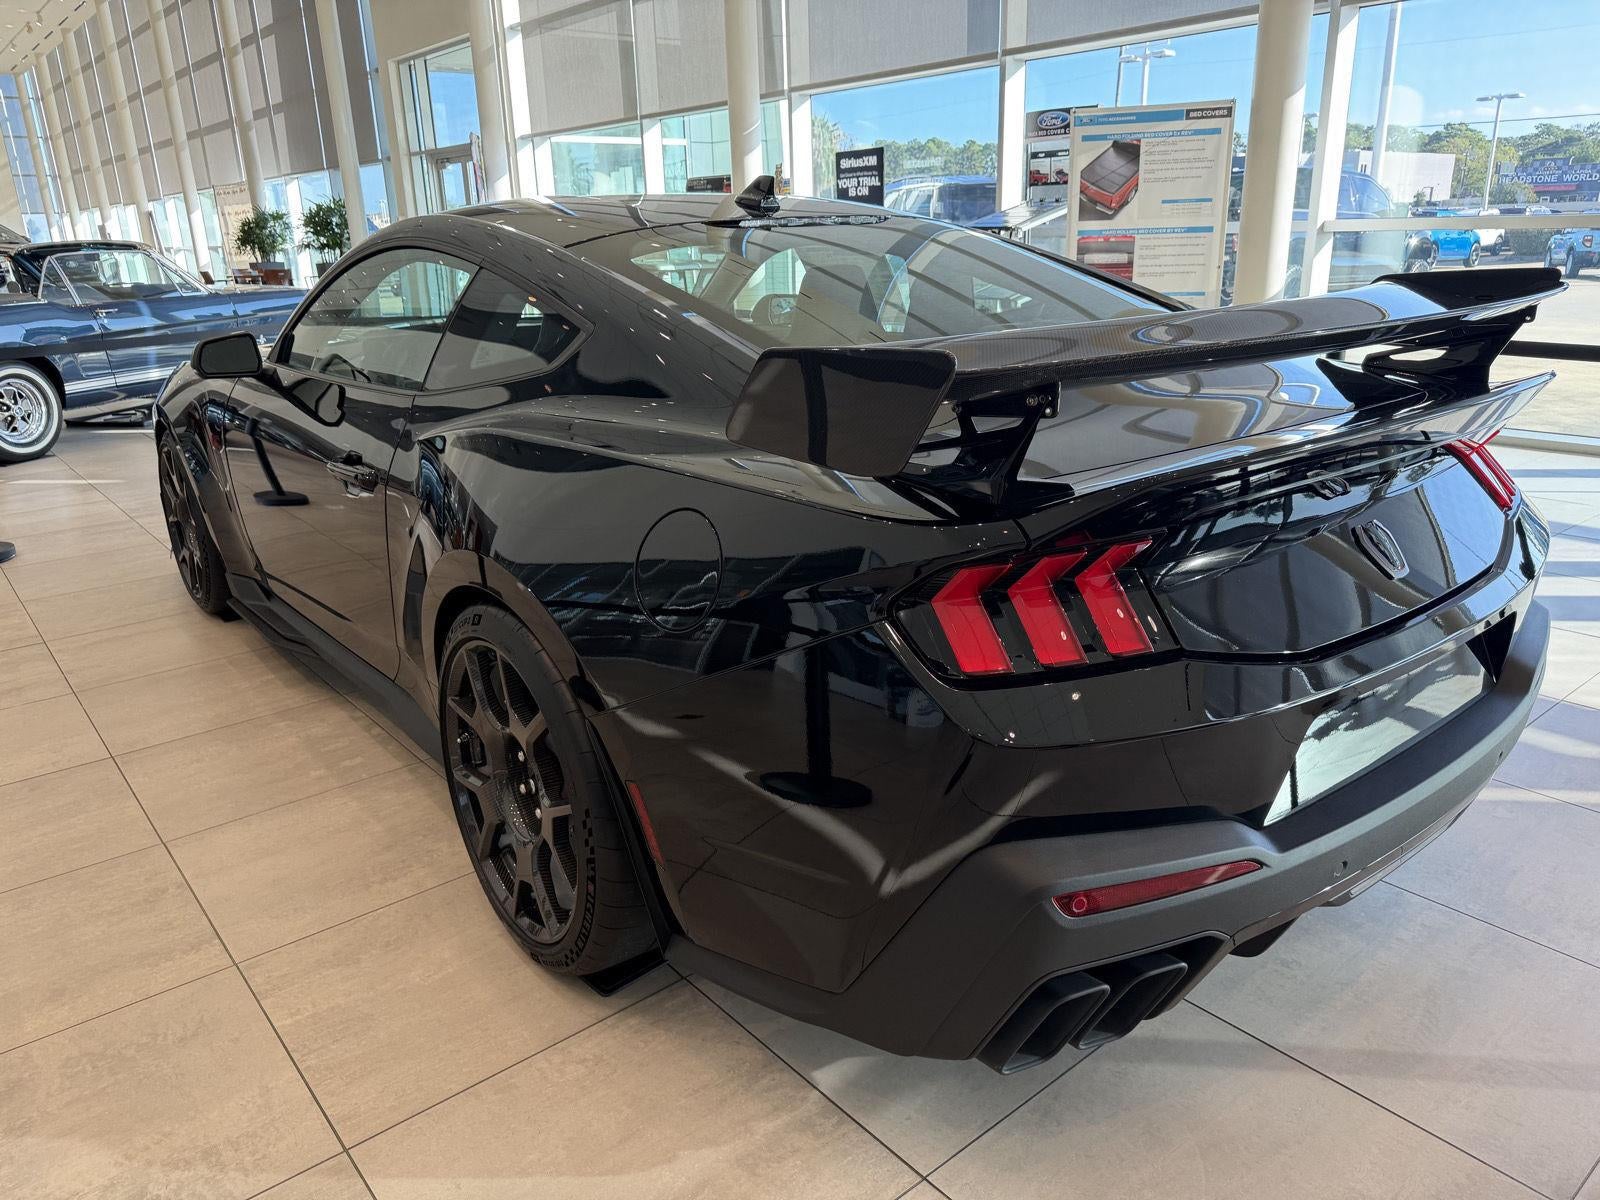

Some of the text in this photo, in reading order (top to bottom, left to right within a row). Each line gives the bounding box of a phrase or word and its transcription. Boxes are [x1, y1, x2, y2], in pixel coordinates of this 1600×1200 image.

[1203, 108, 1228, 117] COVERS
[840, 155, 877, 169] SiriusXM
[838, 175, 880, 189] YOUR TRIAL
[1499, 174, 1558, 184] HEADSTONE
[848, 186, 869, 197] IS ON
